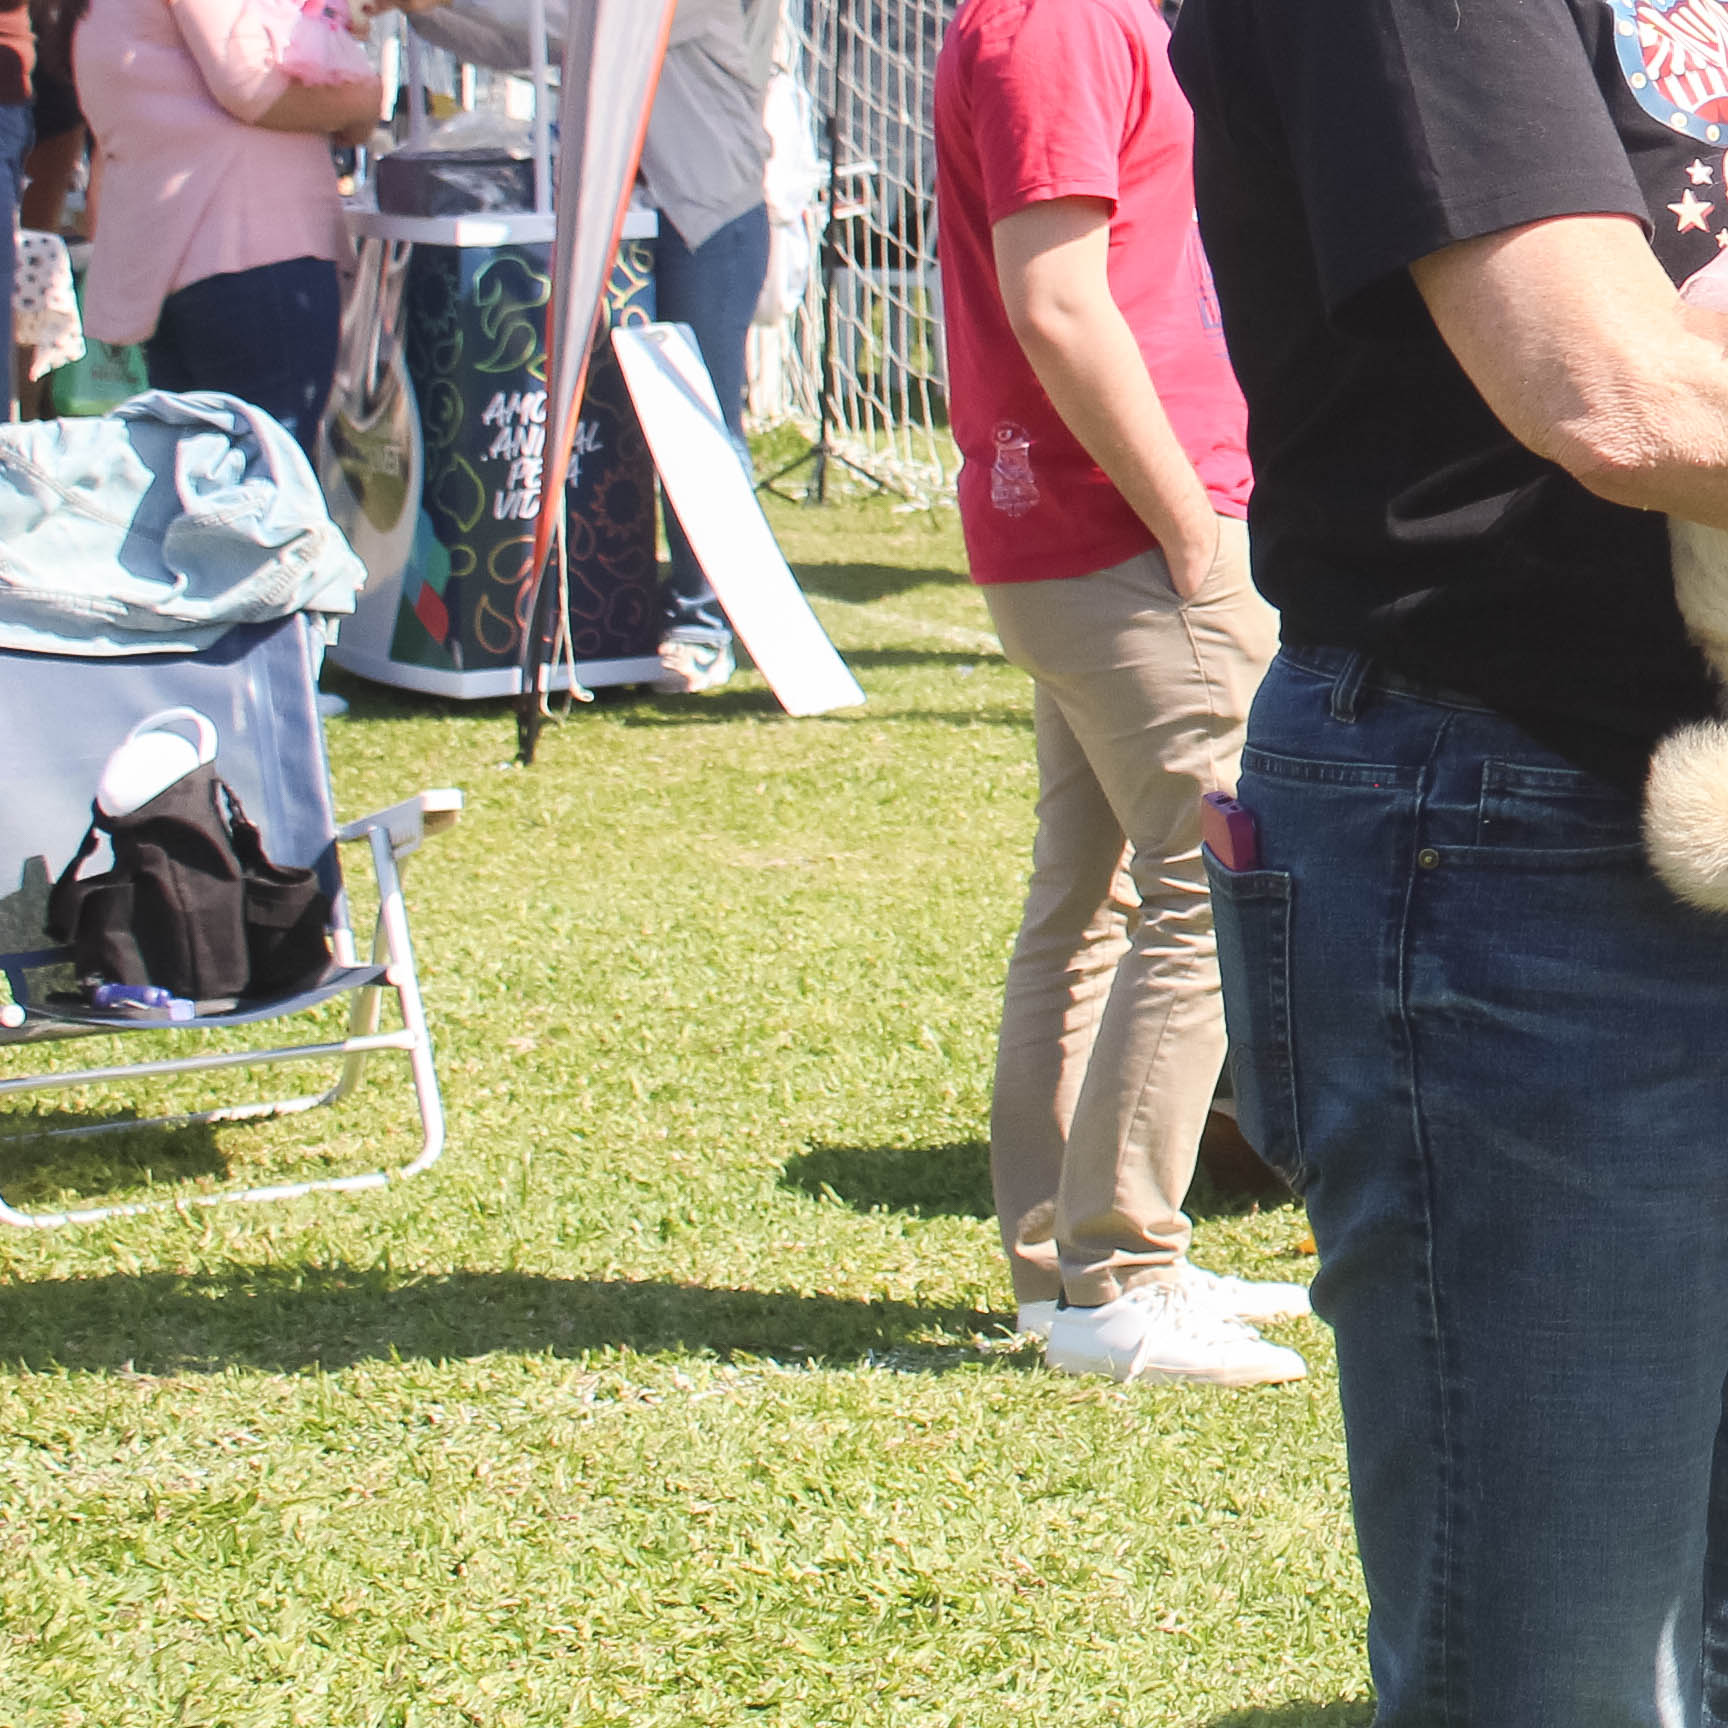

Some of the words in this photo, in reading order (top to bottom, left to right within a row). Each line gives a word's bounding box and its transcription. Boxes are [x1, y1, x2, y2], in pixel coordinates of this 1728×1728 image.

[480, 390, 548, 427] AMO
[488, 420, 604, 461] ANIAL
[505, 453, 583, 489] PEA
[493, 488, 541, 521] VID
